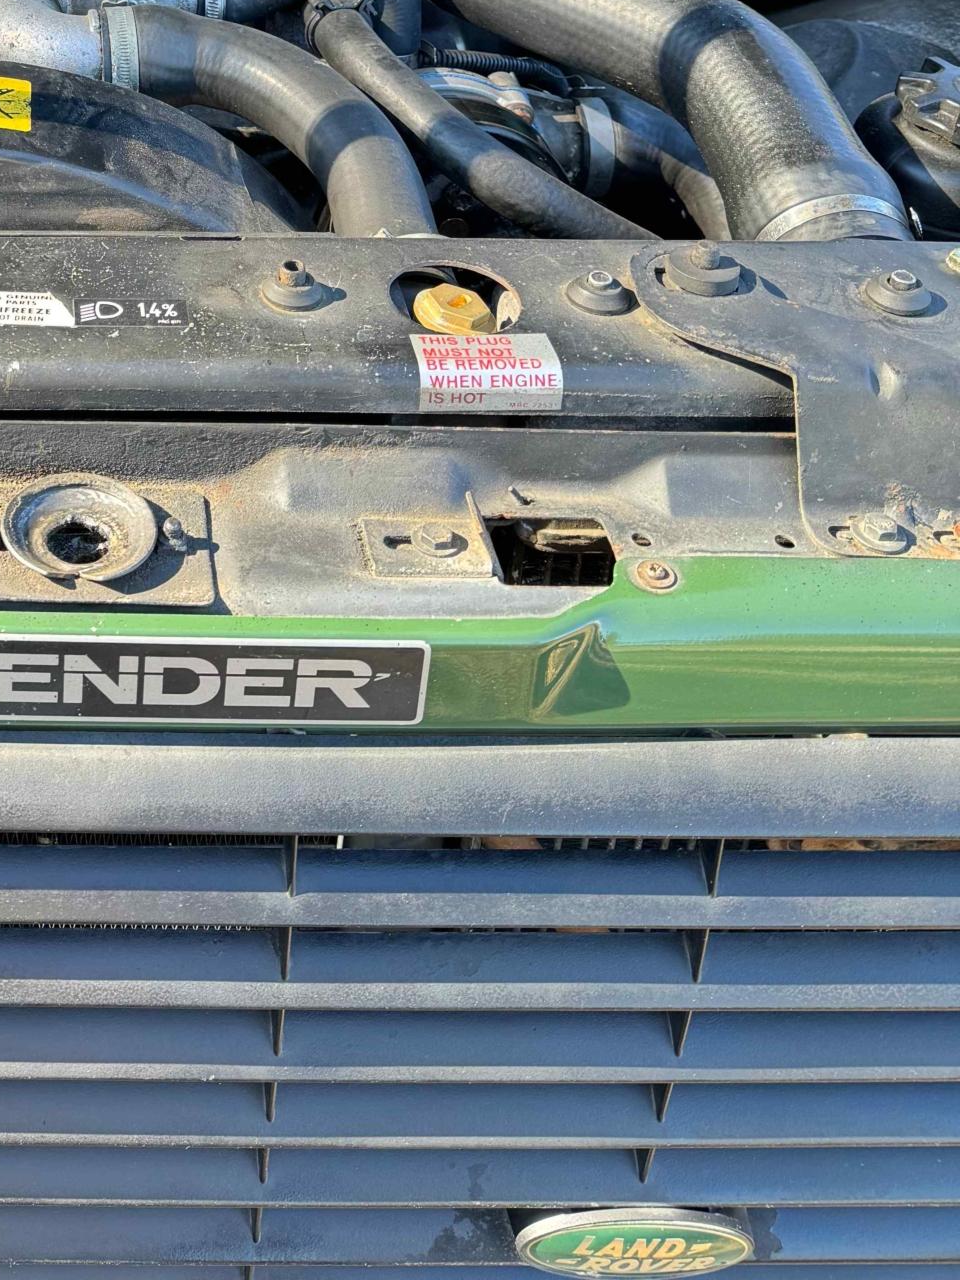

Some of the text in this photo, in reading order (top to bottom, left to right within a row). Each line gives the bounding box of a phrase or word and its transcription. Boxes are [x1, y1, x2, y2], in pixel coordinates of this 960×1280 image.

[137, 302, 178, 319] 1.4%
[419, 336, 512, 345] THIS PLUG
[422, 348, 513, 357] MUST NOT
[426, 358, 542, 370] BE REMOVED
[430, 373, 558, 388] WHEN ENGINE
[428, 392, 486, 403] IS HOT
[572, 1235, 686, 1260] LAND
[577, 1256, 715, 1272] ROVER
